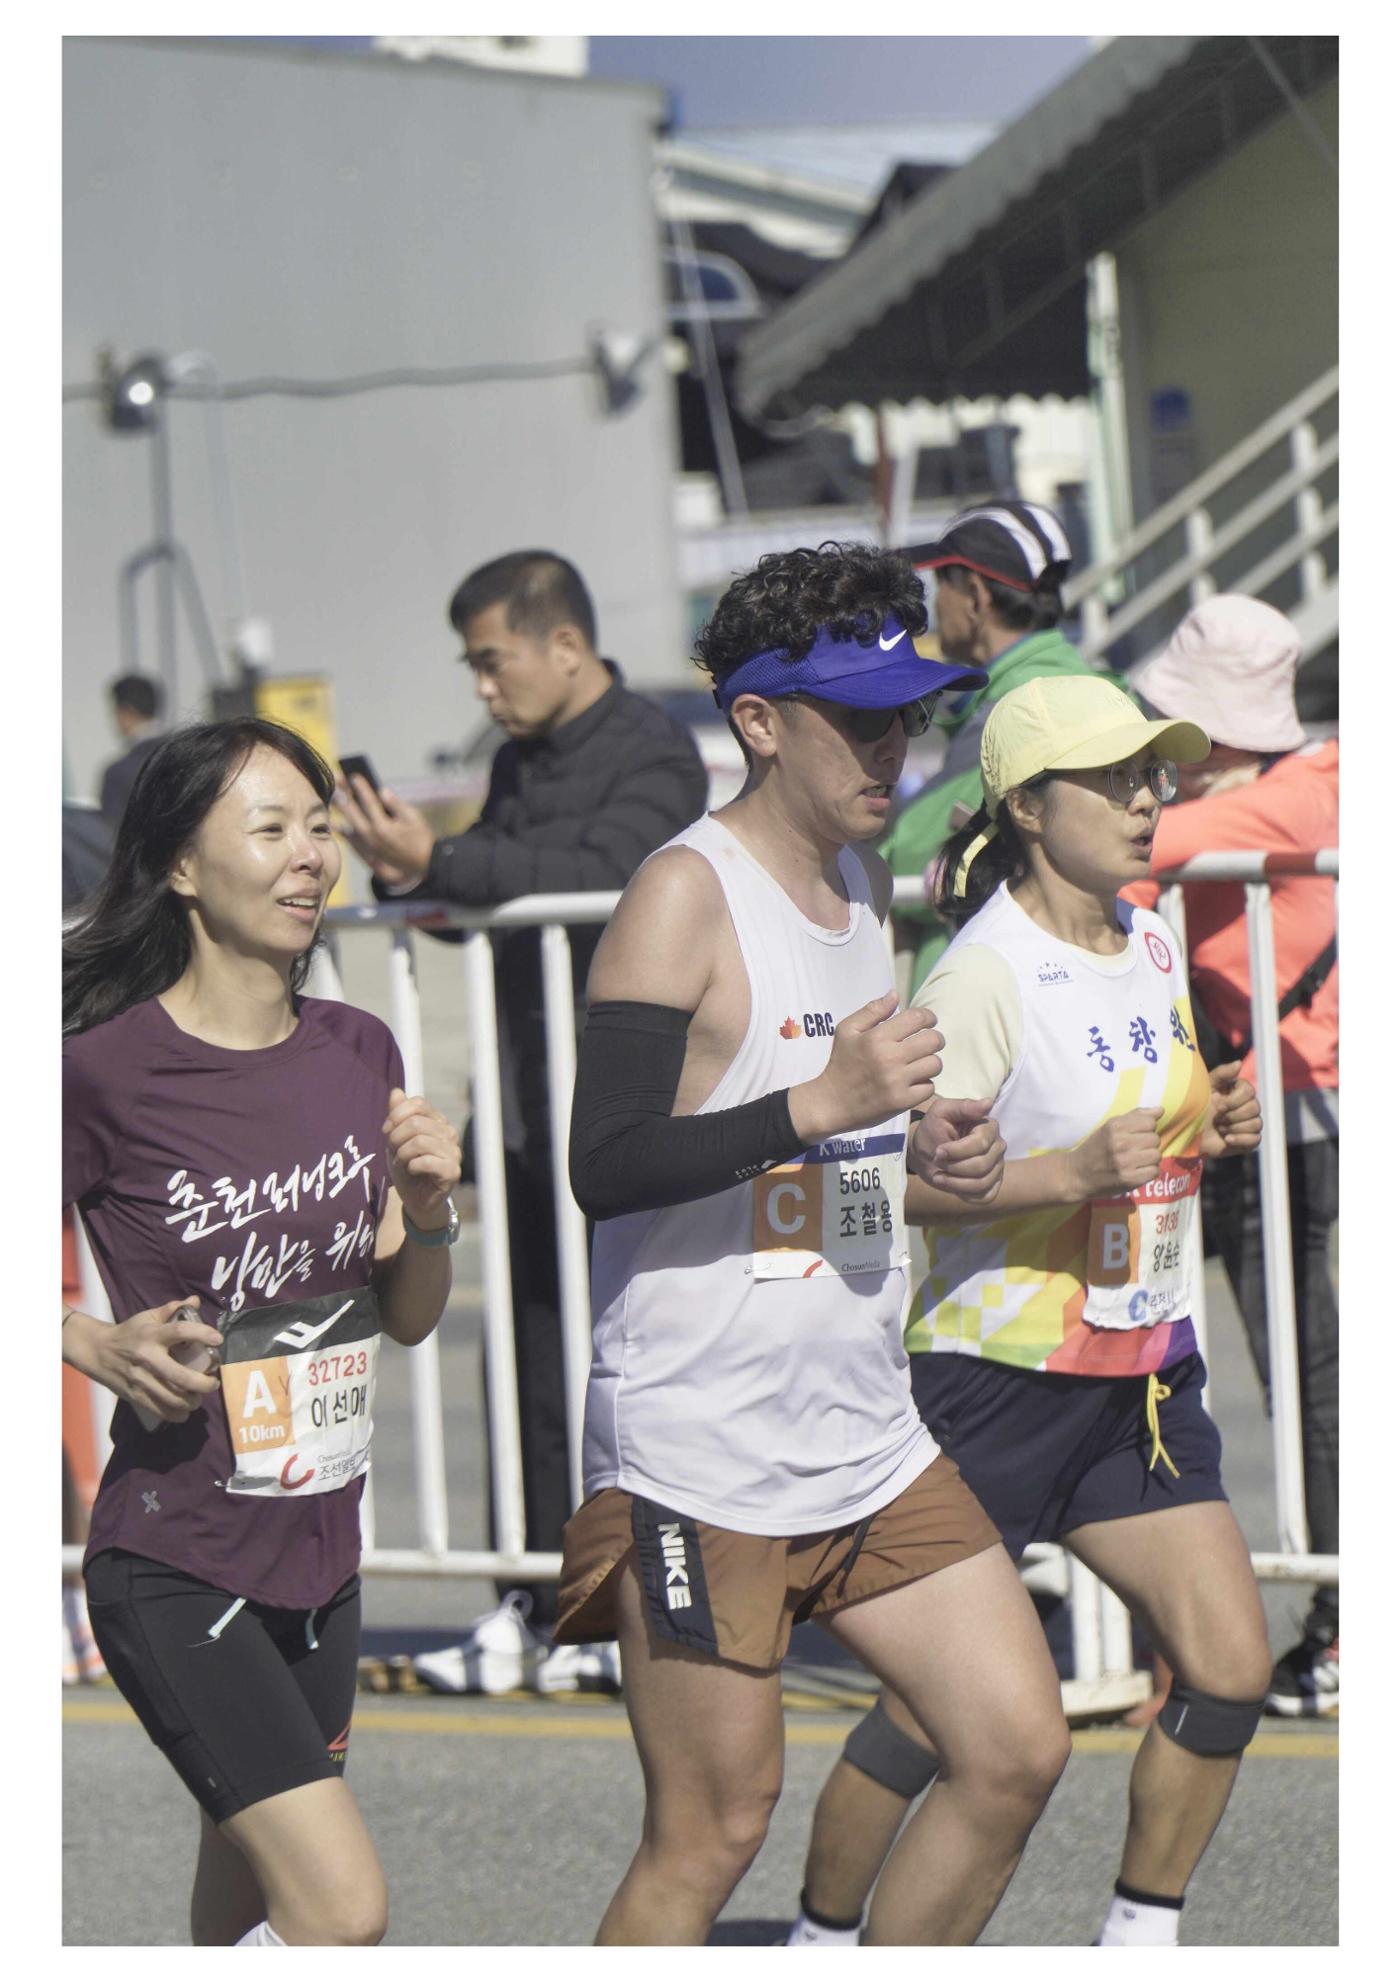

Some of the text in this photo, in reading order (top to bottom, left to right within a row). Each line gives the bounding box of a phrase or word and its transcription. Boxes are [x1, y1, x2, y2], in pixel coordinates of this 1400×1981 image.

[803, 1012, 835, 1038] CRC
[839, 1167, 881, 1195] 5606
[766, 1183, 806, 1234] C
[839, 1199, 893, 1238] 조철용
[1103, 1223, 1130, 1270] B
[307, 1351, 368, 1386] 32723
[242, 1370, 277, 1419] A
[311, 1384, 368, 1428] 이선애
[239, 1424, 285, 1444] 10km
[657, 1522, 692, 1610] NIKE
